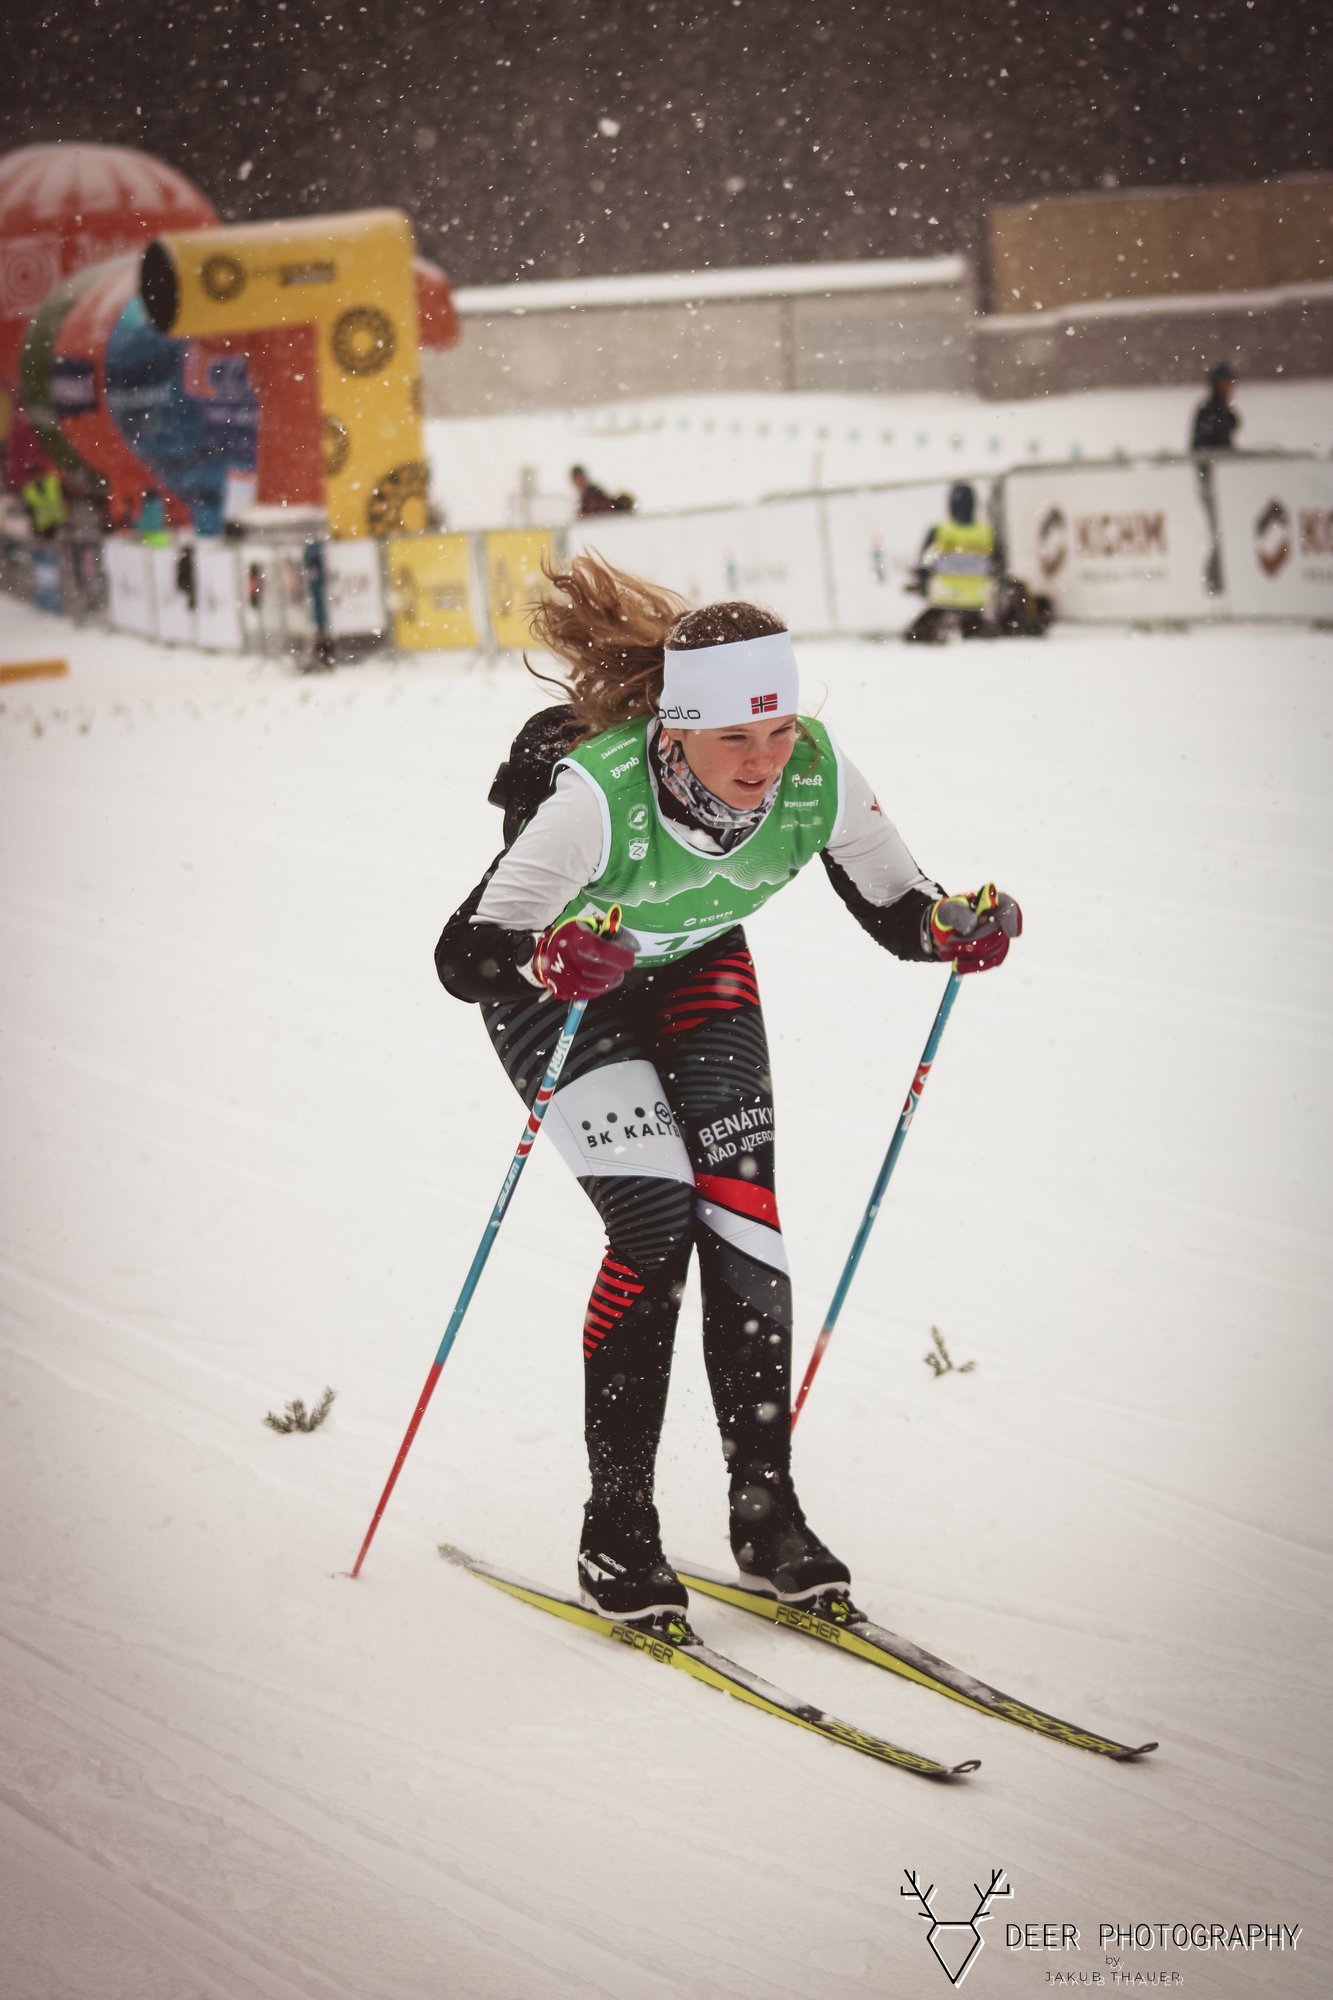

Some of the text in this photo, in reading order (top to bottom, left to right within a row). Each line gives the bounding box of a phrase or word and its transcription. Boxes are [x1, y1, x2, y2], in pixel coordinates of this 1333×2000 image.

[658, 706, 701, 720] odlo
[610, 757, 640, 779] quest
[792, 773, 823, 788] quest
[700, 911, 733, 923] KGHM
[699, 1107, 773, 1147] BENÁTKY
[587, 1131, 613, 1148] BK
[707, 1142, 738, 1166] NAD
[776, 1605, 841, 1643] FISCHER
[611, 1625, 674, 1664] FISCHER
